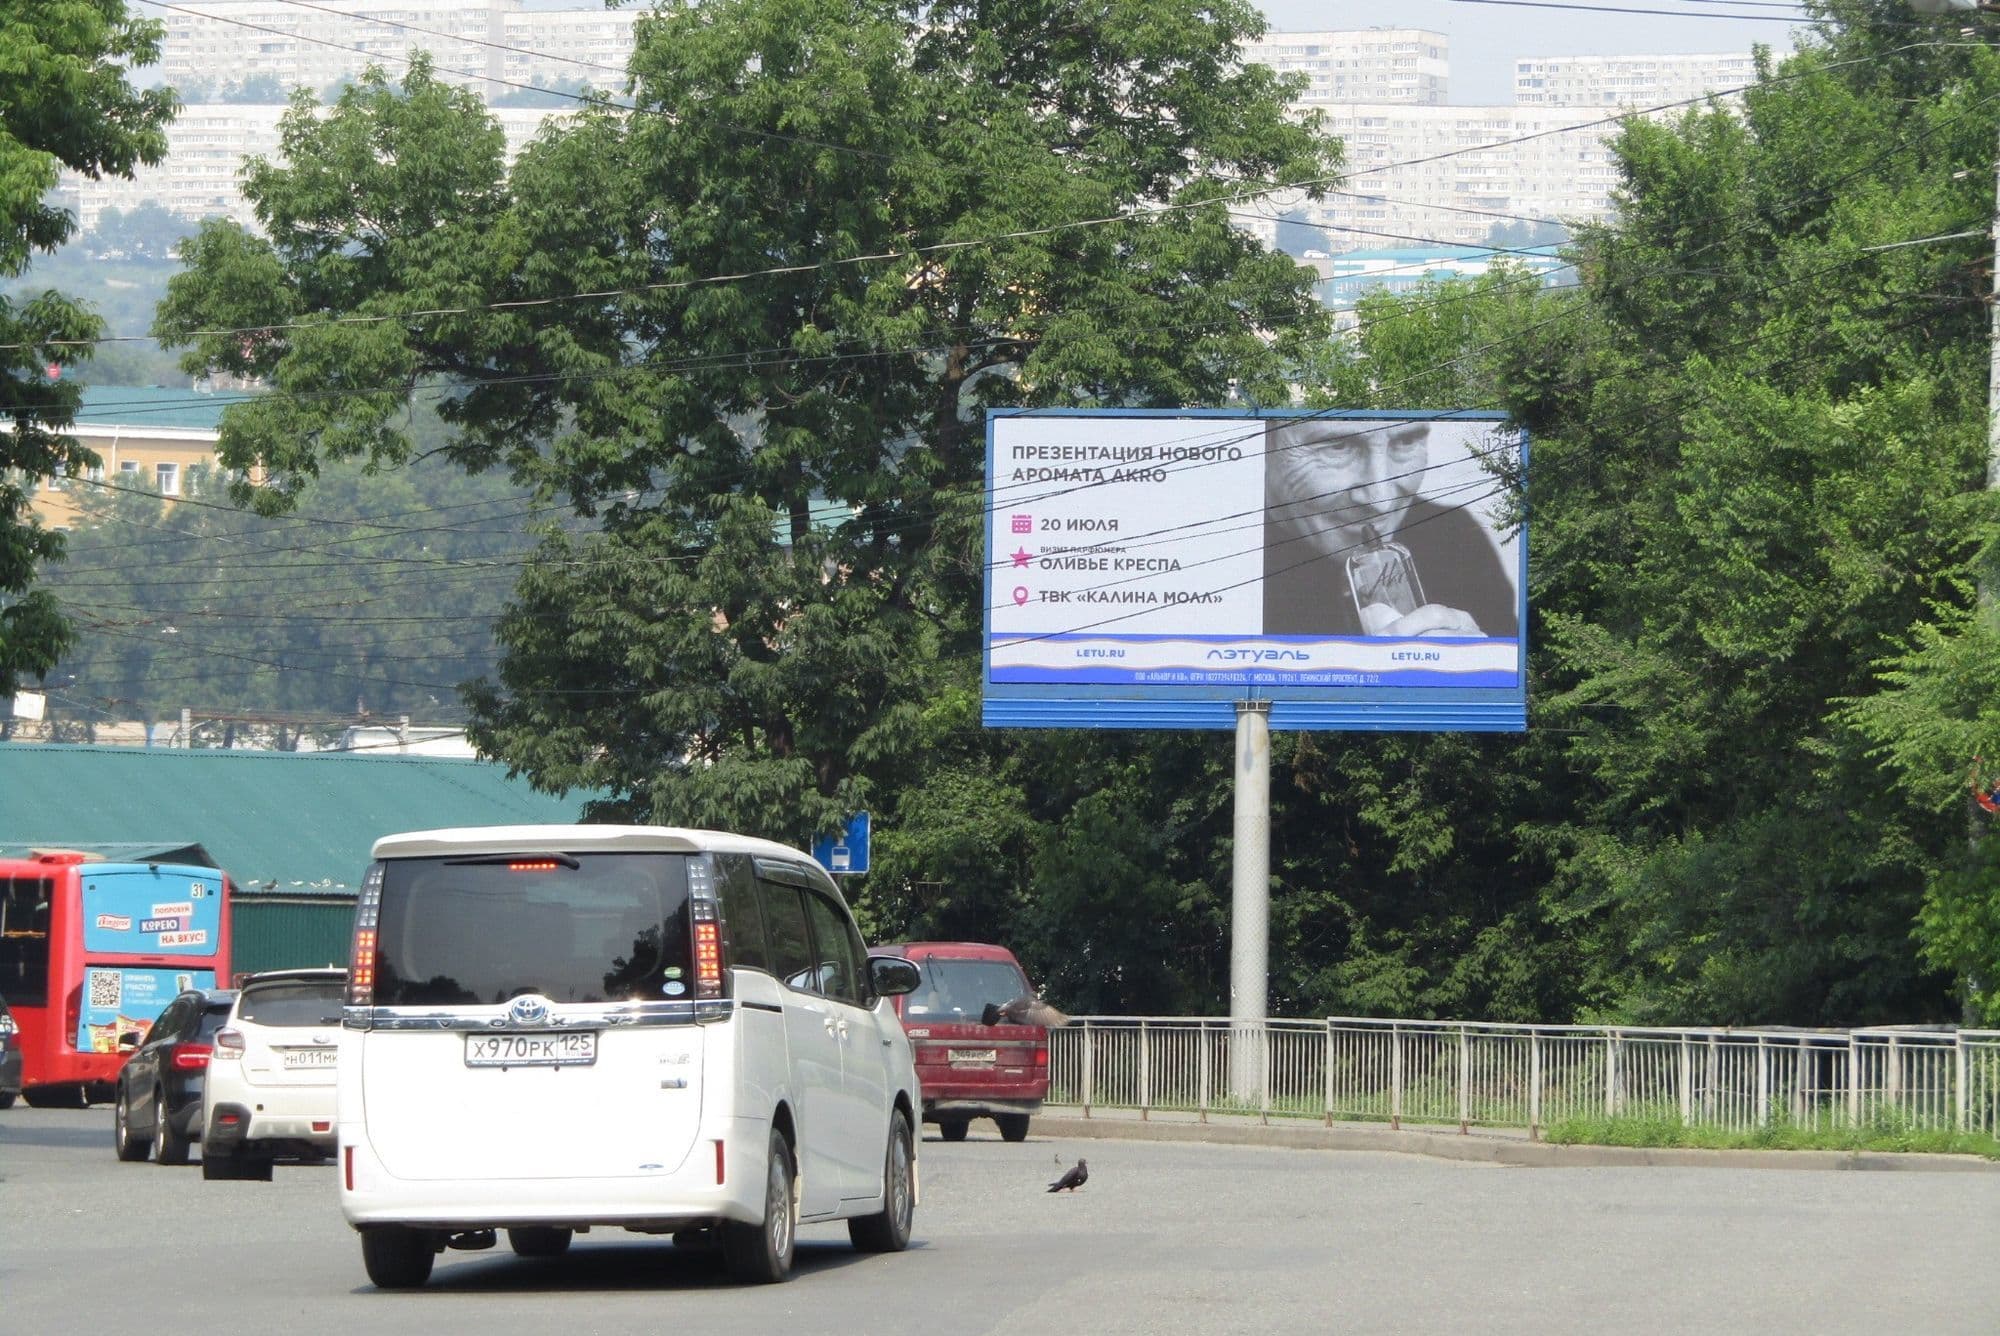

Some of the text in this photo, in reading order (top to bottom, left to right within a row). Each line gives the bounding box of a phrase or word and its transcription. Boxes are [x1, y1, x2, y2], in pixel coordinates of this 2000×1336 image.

[1012, 446, 1242, 462] ПРЕЗЕНТАЦИЯ НОВОГО
[1012, 468, 1167, 483] АРОМАТА AKRO
[1040, 519, 1118, 531] 20 ИЮЛЯ
[1040, 546, 1067, 554] ВИЗИТ
[1040, 558, 1182, 571] ОЛИВЬЕ КРЕСПА
[1039, 591, 1223, 604] ТВК «КАЛИНА МОЛЛ»
[1076, 649, 1125, 658] LETU.RU
[1391, 652, 1440, 661] LETU.RU
[192, 884, 203, 897] 31
[161, 933, 204, 944] НА ВКУС!
[474, 1035, 590, 1058] Х970РК 125
